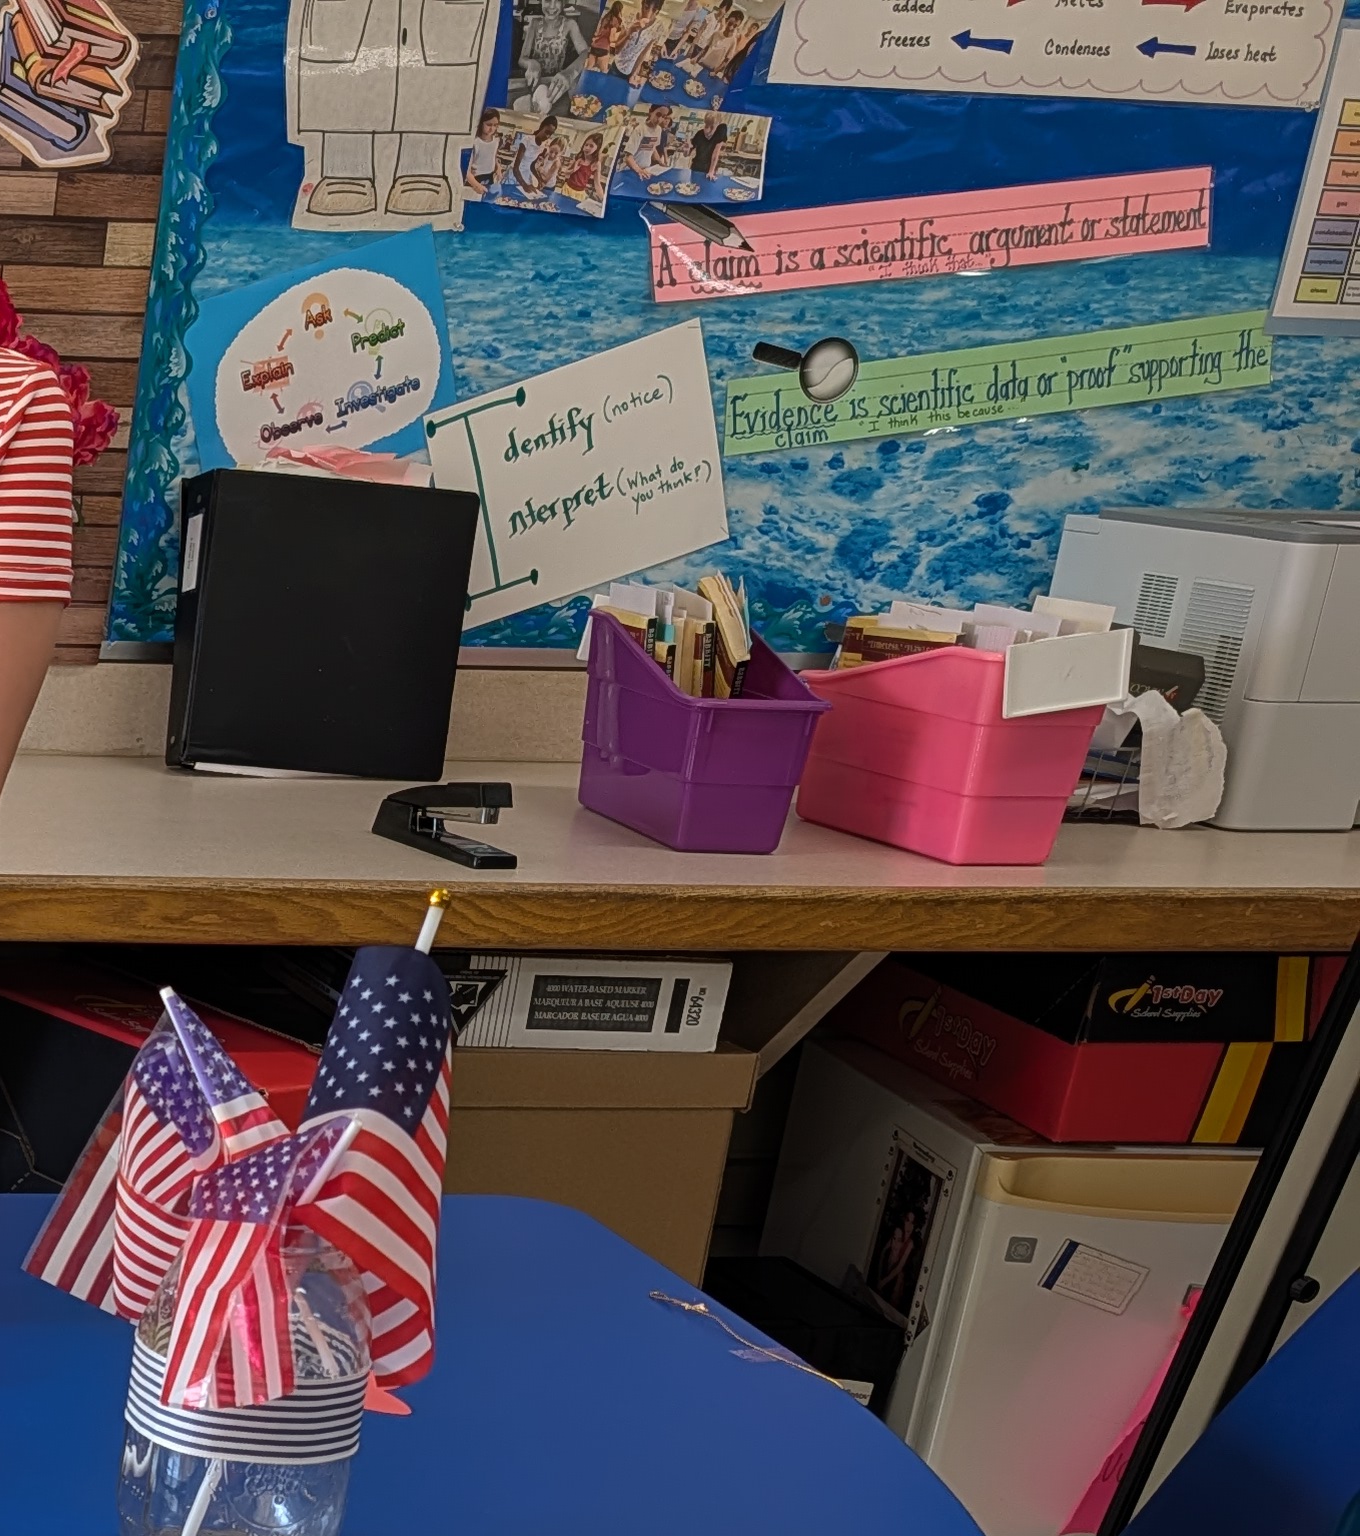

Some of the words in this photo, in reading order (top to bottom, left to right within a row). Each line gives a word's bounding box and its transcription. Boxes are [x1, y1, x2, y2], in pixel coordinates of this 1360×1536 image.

[892, 0, 934, 13] added
[1224, 0, 1304, 21] Evaporates
[880, 31, 931, 48] Freezes
[1045, 38, 1111, 56] Condenses
[1205, 41, 1239, 61] Loses
[1244, 44, 1276, 62] heat
[656, 241, 677, 288] A
[774, 244, 800, 275] is
[809, 247, 826, 270] a
[833, 219, 953, 267] scientific
[969, 202, 1074, 269] argument
[1080, 218, 1102, 242] or
[1104, 188, 1207, 238] statement
[304, 305, 333, 331] Ask
[350, 318, 405, 353] Predict
[240, 361, 295, 391] Explain
[730, 388, 838, 438] Evidence
[850, 389, 869, 420] is
[877, 367, 974, 419] scientific
[986, 360, 1030, 404] data
[1036, 371, 1058, 398] or
[1128, 338, 1222, 395] supporting
[1232, 329, 1269, 372] the
[334, 375, 421, 419] Investigate
[604, 374, 673, 424] (notice)
[259, 411, 324, 444] Observe
[774, 425, 829, 449] claim
[670, 456, 684, 474] do
[632, 491, 653, 515] you
[561, 985, 613, 994] WATER-BASED
[615, 986, 647, 995] MARKER
[686, 996, 705, 1026] 64320
[1163, 1008, 1201, 1022] Supplies
